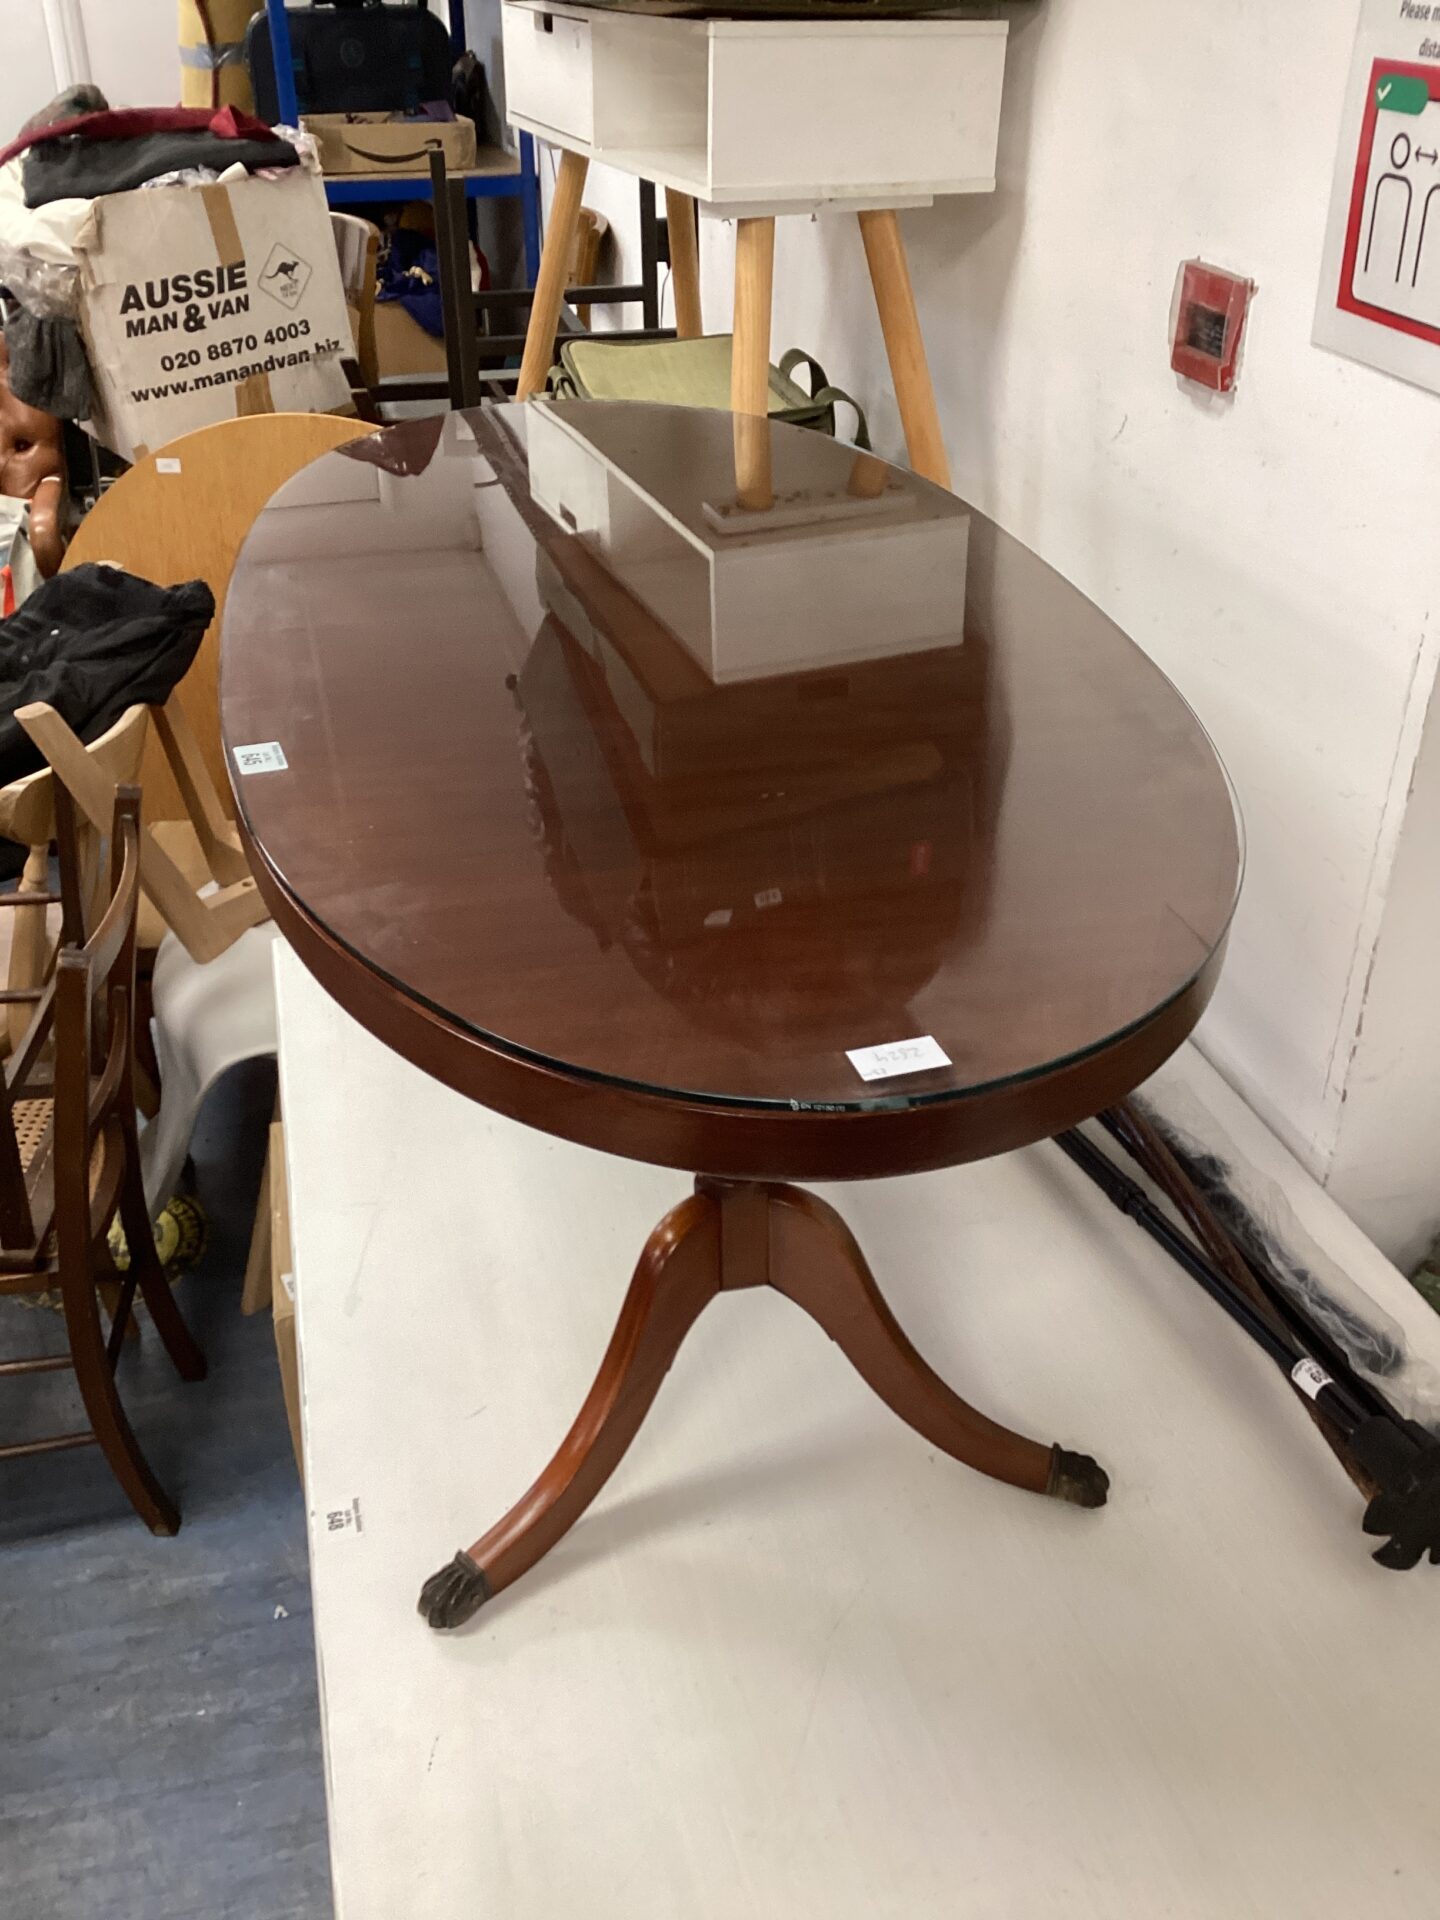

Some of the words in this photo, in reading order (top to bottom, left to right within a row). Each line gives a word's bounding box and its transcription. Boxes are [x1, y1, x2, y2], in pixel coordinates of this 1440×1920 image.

[1400, 0, 1431, 20] Please
[120, 260, 247, 315] AUSSIE
[126, 311, 178, 338] MAN
[183, 303, 207, 333] &
[208, 294, 249, 320] VAN
[161, 349, 201, 372] 020
[206, 334, 257, 361] 8870
[263, 319, 311, 345] 4003
[131, 338, 341, 402] www.manandvanbiz
[327, 1510, 344, 1531] 648
